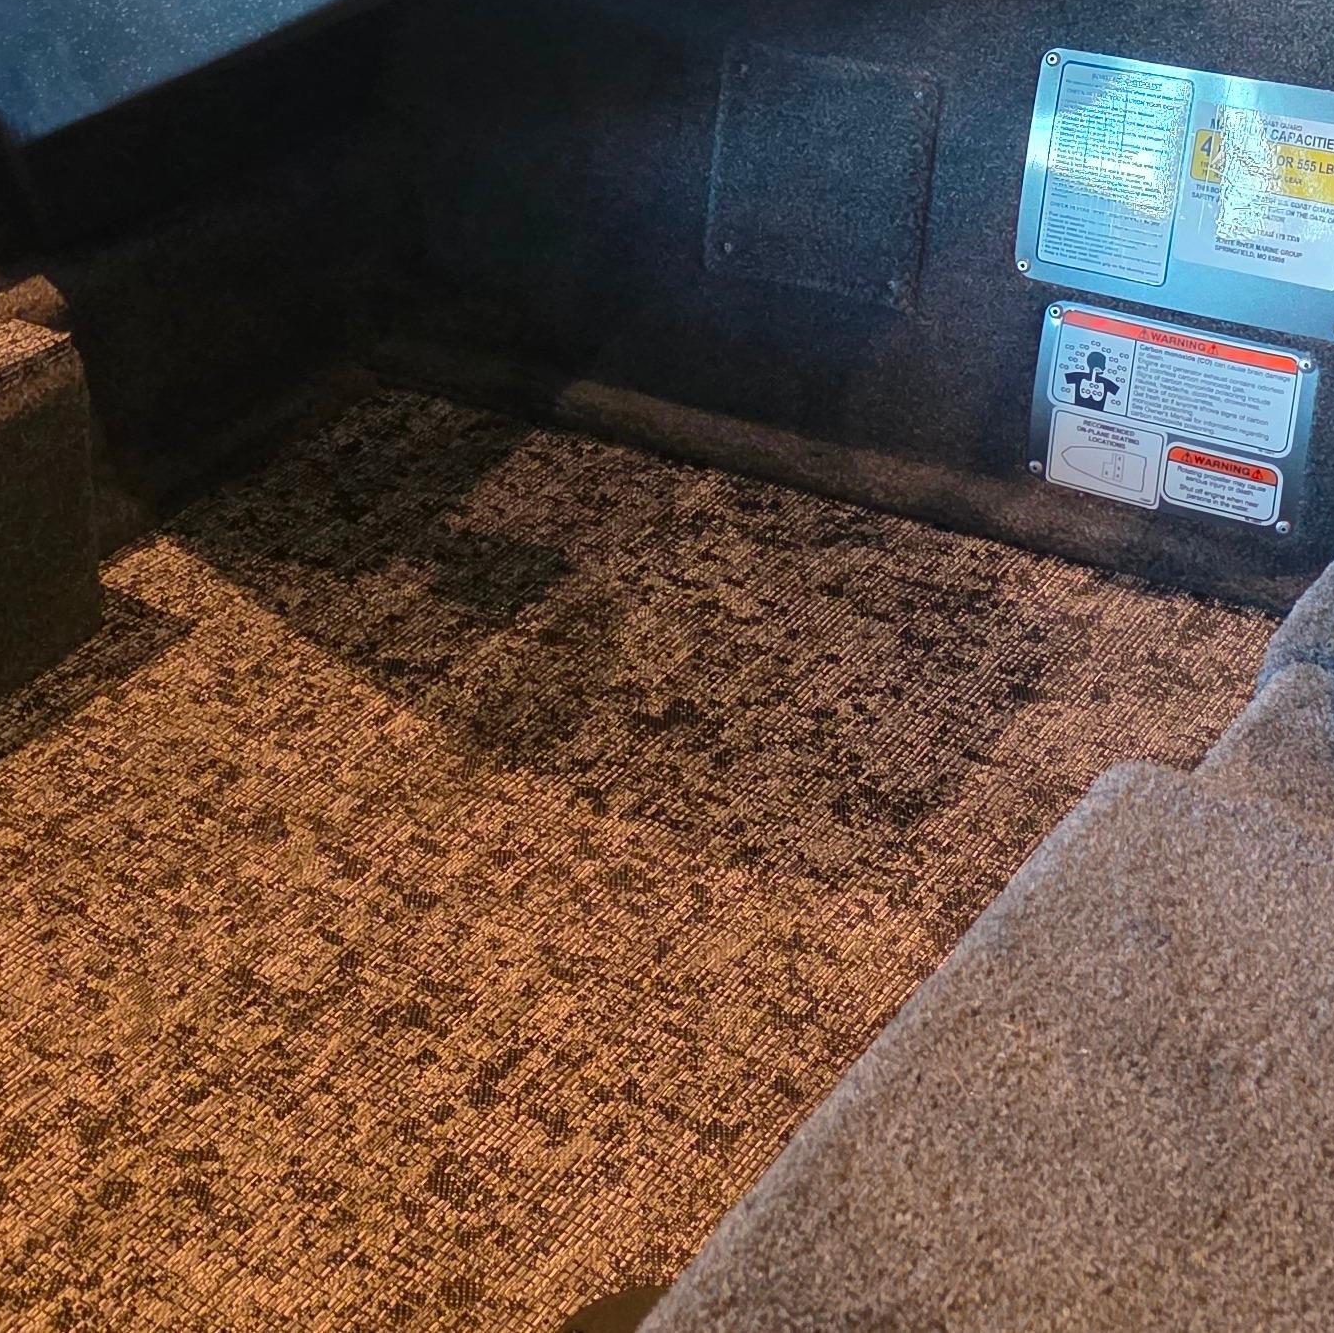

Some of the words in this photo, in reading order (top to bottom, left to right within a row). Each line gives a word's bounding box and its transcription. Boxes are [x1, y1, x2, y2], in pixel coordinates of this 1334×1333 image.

[1199, 134, 1215, 157] 4
[1276, 154, 1295, 168] OR
[1297, 158, 1317, 172] 555
[1280, 248, 1304, 259] GROUP
[1150, 332, 1207, 352] WARNING
[1119, 352, 1130, 360] CO
[1083, 418, 1135, 438] RECOMMENDED
[1088, 435, 1126, 451] LOCATIONS
[1193, 455, 1252, 476] WARNING
